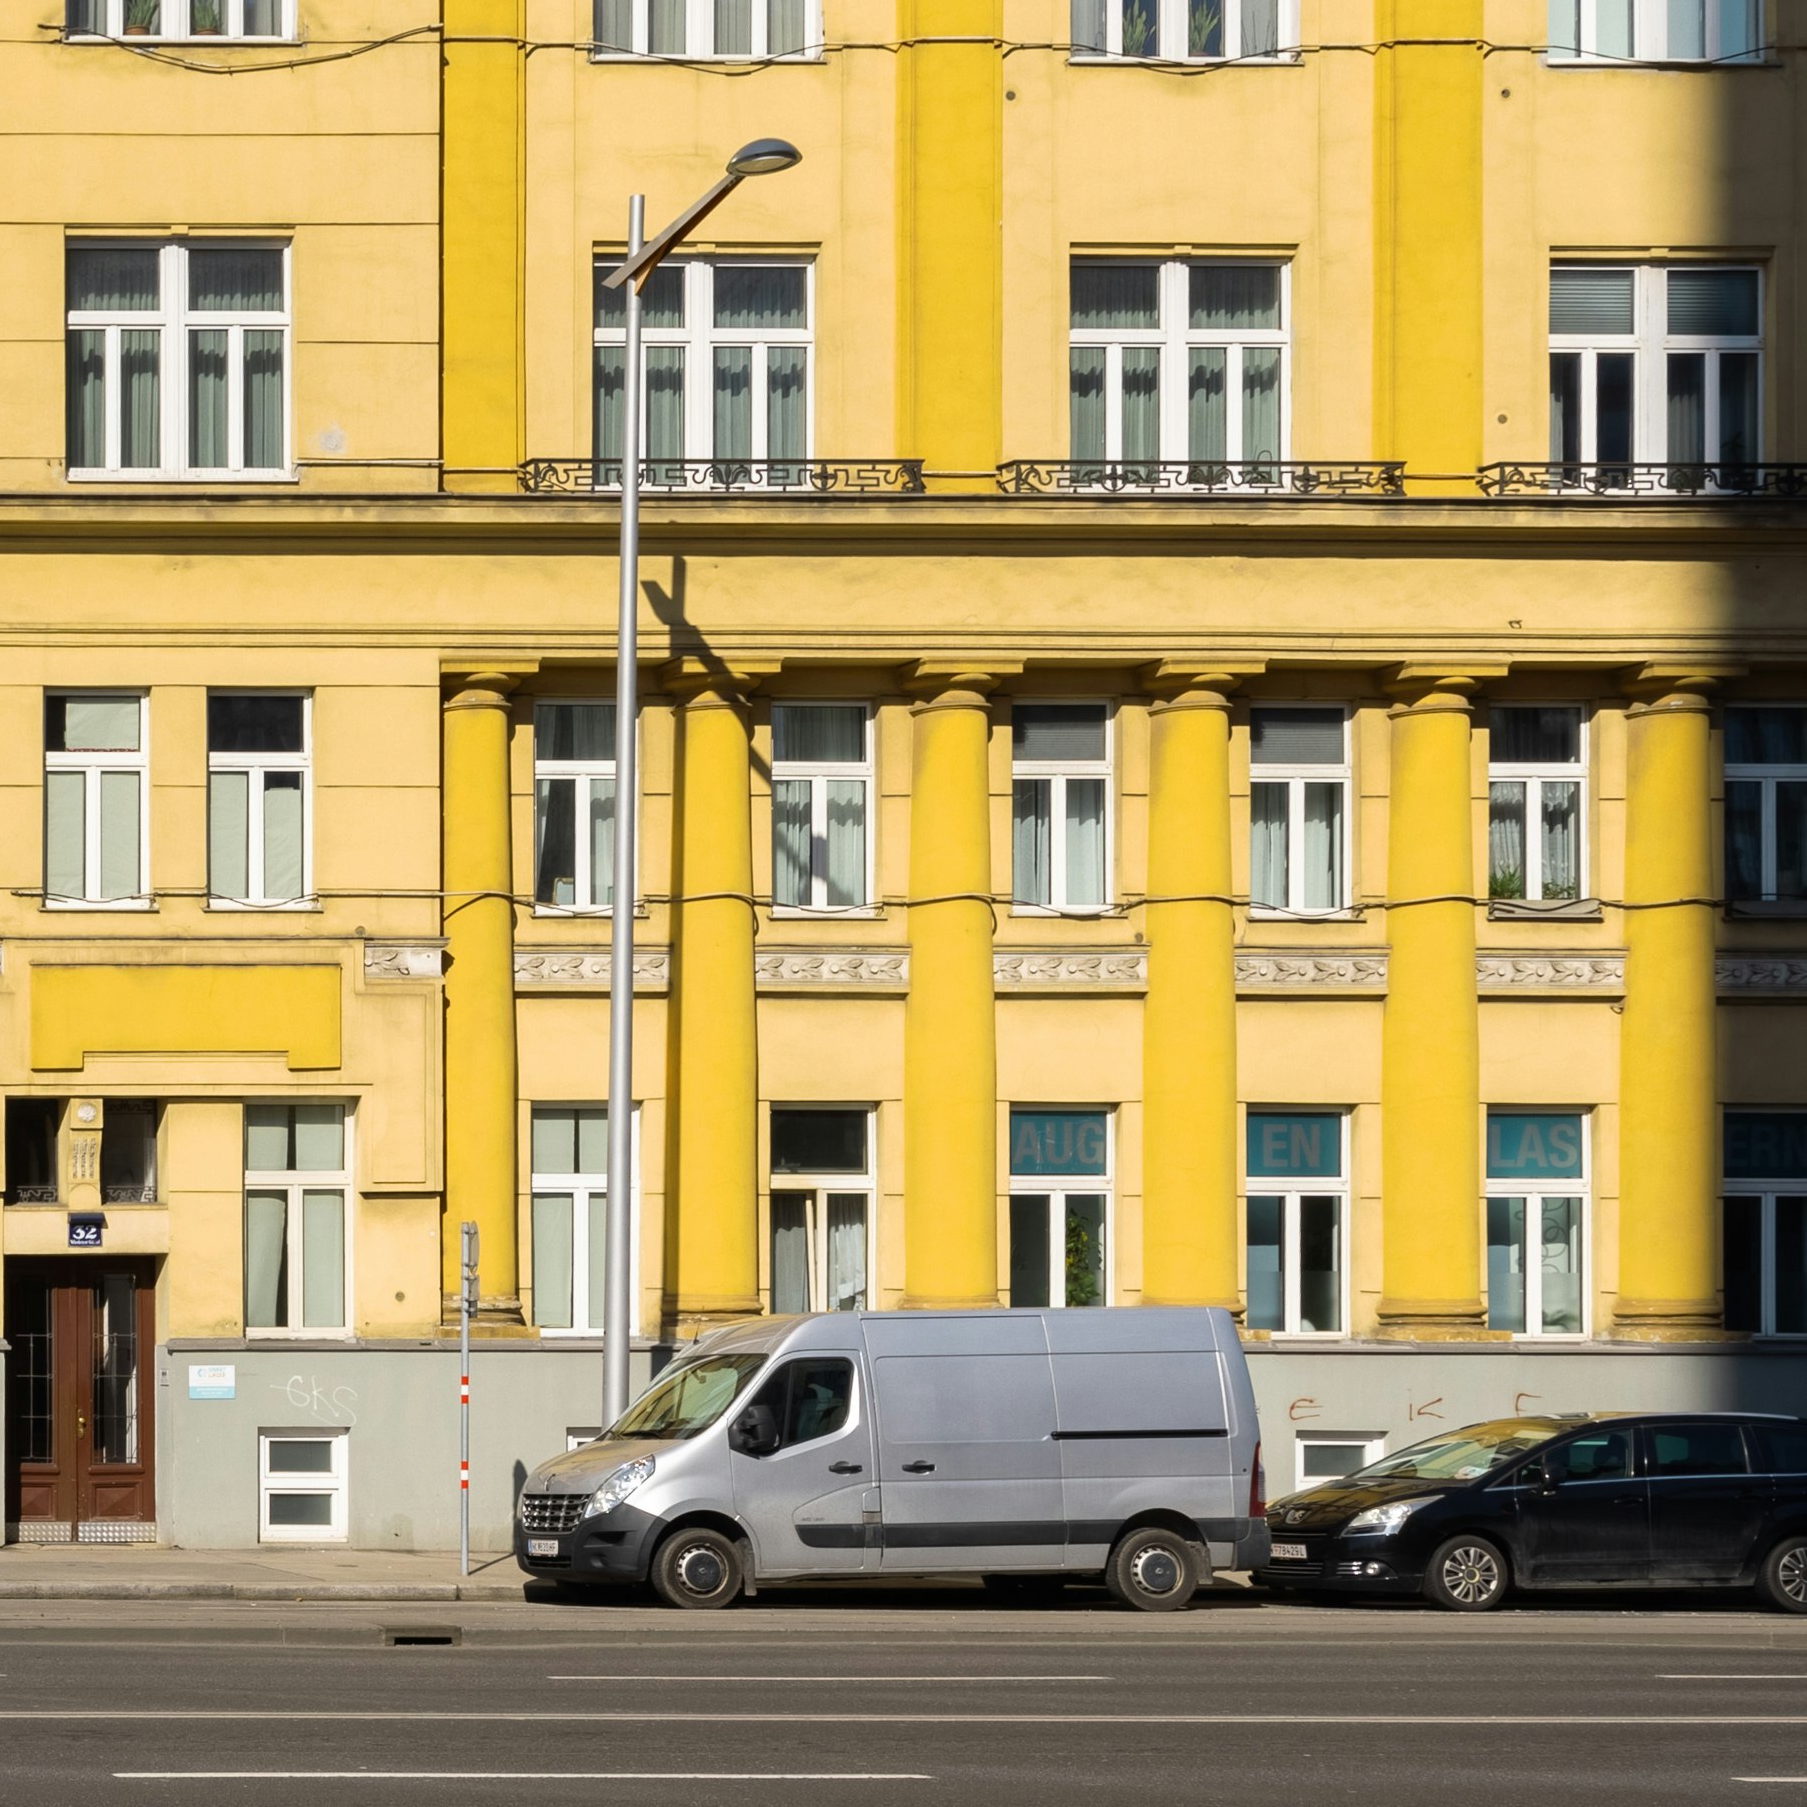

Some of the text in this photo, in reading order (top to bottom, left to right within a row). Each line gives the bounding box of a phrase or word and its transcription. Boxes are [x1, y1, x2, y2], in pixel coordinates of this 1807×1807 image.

[1262, 1123, 1321, 1168] EN
[1490, 1124, 1578, 1168] LAS
[73, 1225, 98, 1240] 32
